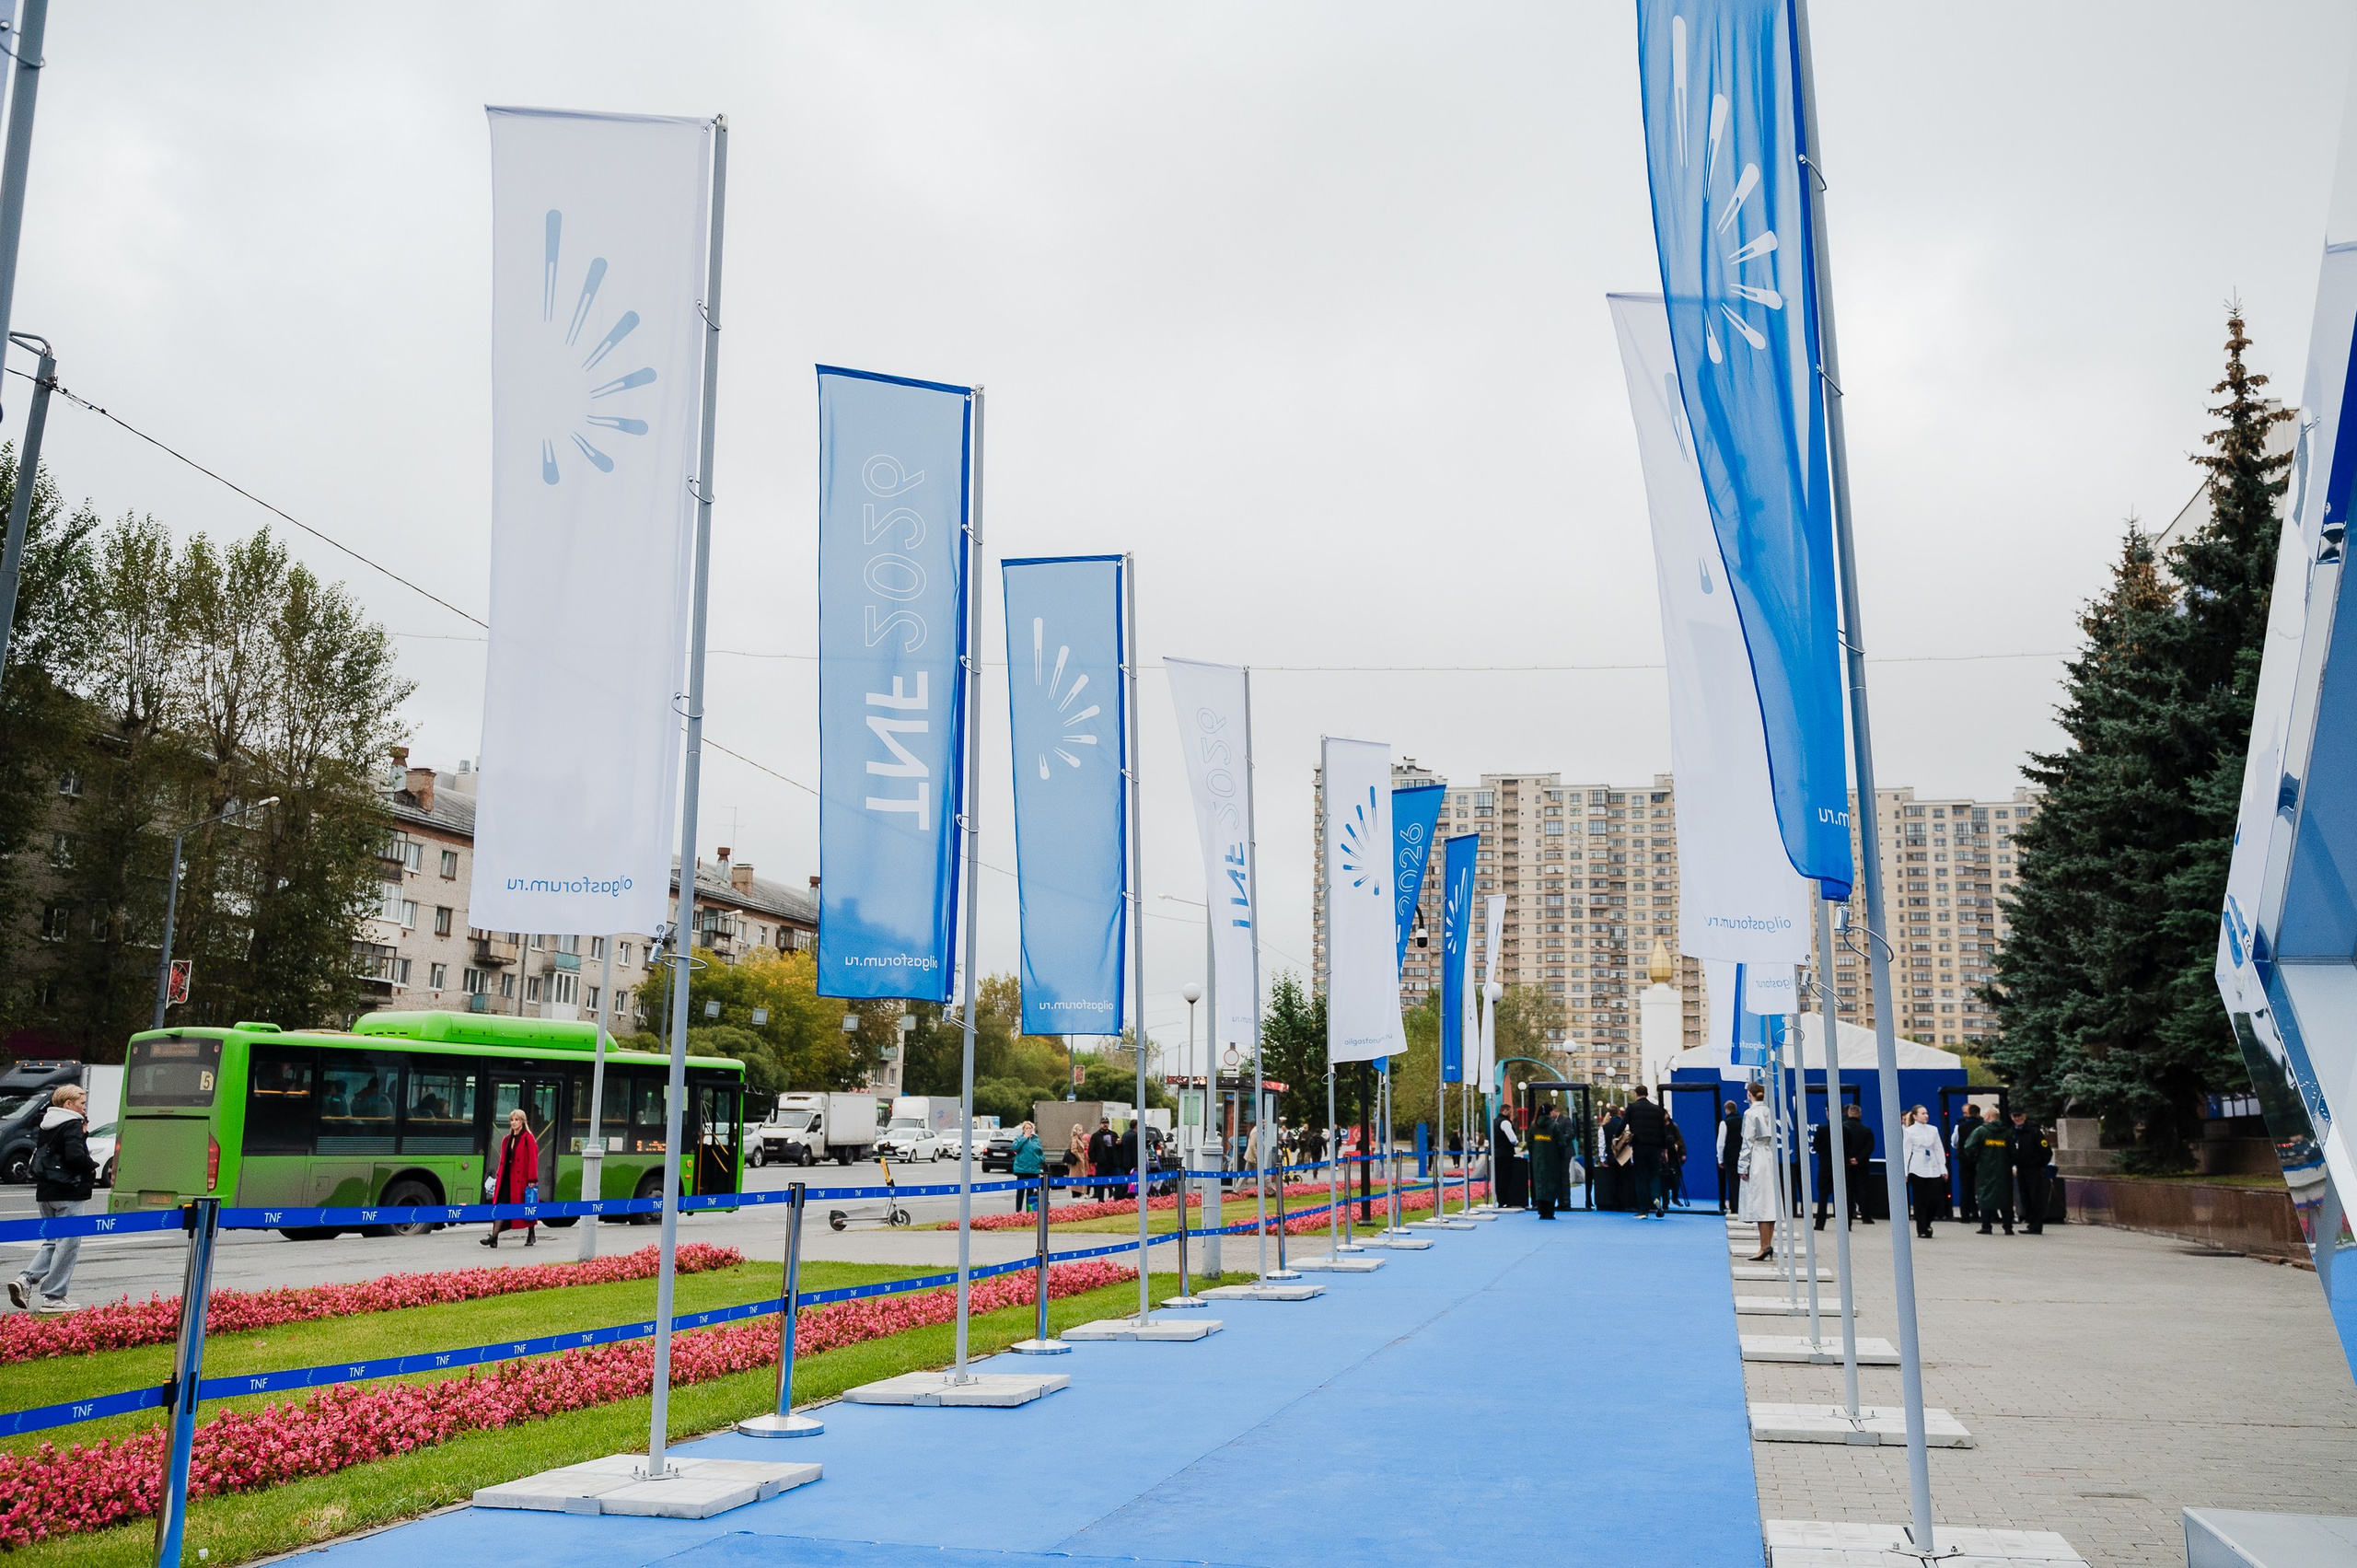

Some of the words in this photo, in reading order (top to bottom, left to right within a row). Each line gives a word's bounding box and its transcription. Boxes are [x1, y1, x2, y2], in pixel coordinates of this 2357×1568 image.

[203, 1074, 211, 1089] 5
[574, 1139, 581, 1151] 5
[264, 1212, 282, 1223] TNF
[362, 1211, 377, 1221] TNF
[447, 1209, 462, 1218] TNF
[524, 1206, 537, 1215] TNF
[592, 1203, 603, 1213] TNF
[653, 1201, 663, 1209] TNF
[757, 1194, 766, 1202] TNF
[96, 1218, 116, 1231] TNF
[250, 1377, 269, 1390] TNF
[349, 1366, 366, 1377] TNF
[435, 1355, 450, 1366] TNF
[514, 1344, 527, 1354] TNF
[582, 1334, 594, 1343] TNF
[643, 1324, 654, 1333] TNF
[699, 1314, 709, 1324] TNF
[749, 1305, 758, 1315] TNF
[73, 1404, 93, 1419] TNF
